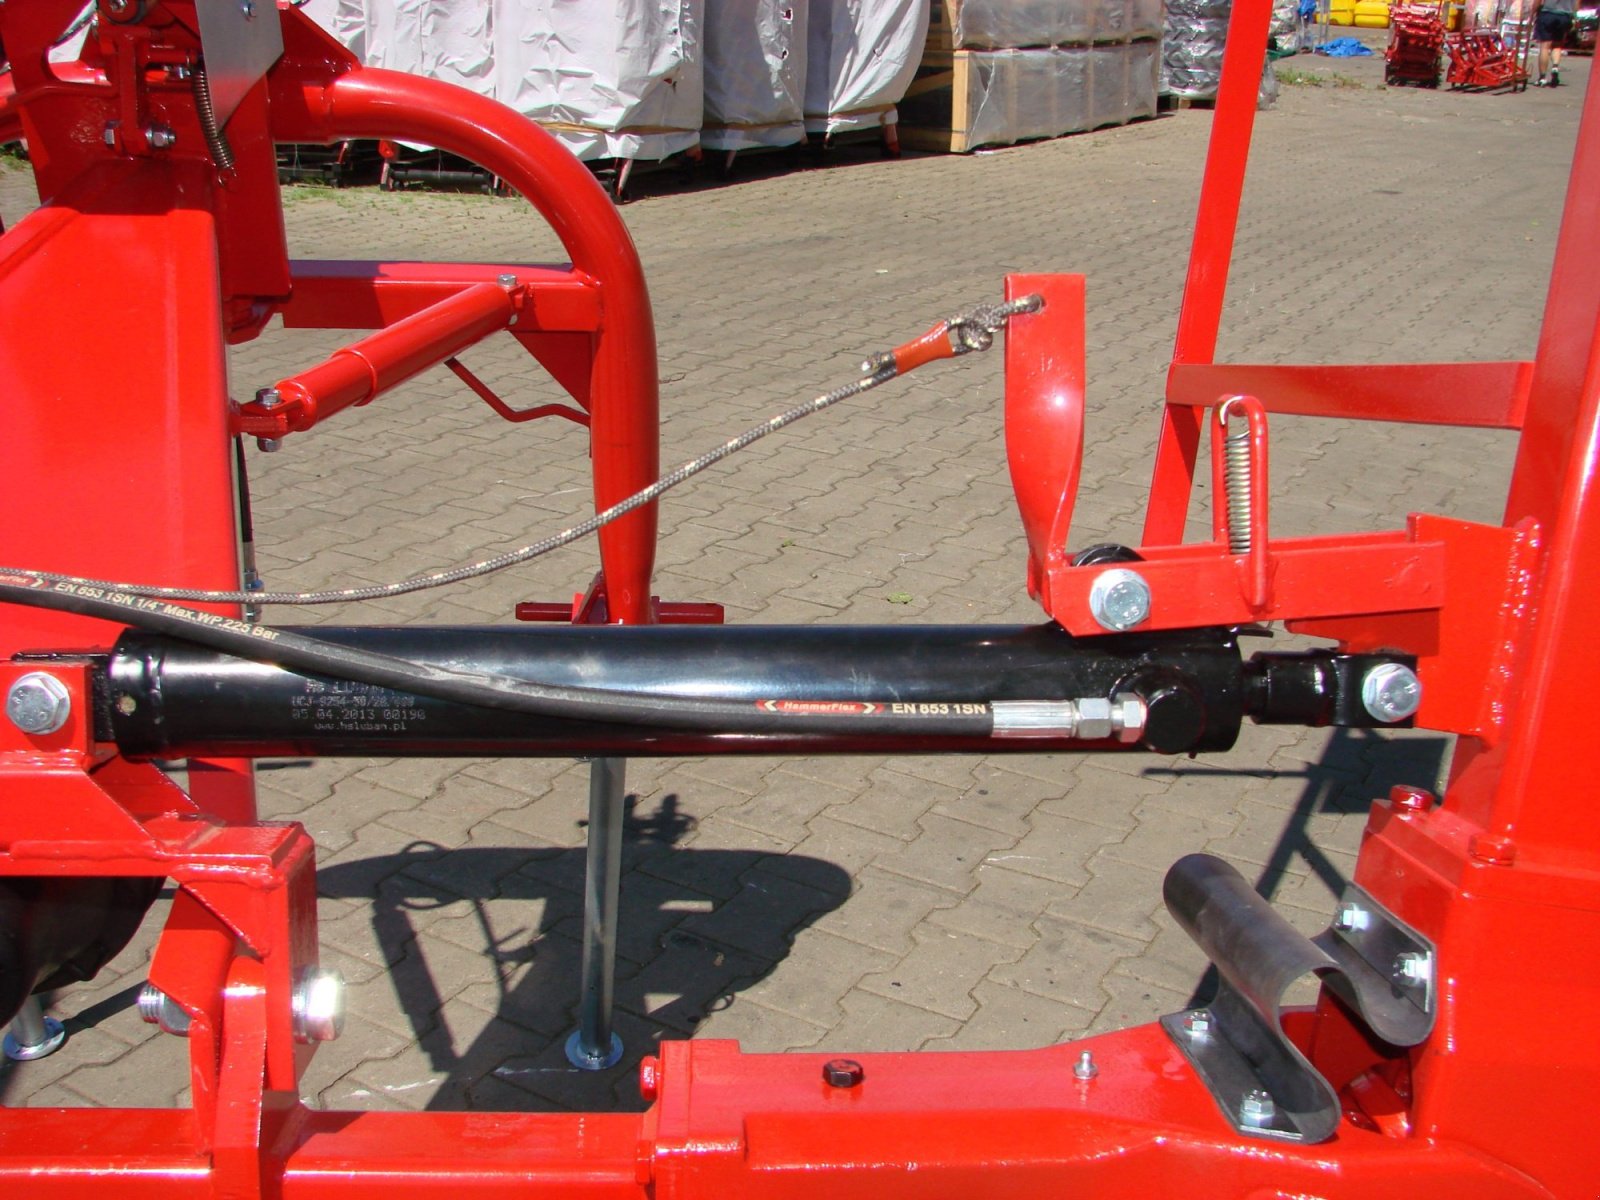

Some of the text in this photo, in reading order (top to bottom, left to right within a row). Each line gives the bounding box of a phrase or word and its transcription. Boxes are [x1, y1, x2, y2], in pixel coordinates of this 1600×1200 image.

[54, 582, 77, 593] EN
[78, 586, 105, 598] 853
[106, 592, 135, 605] 1SN
[251, 625, 281, 641] Bar
[783, 701, 987, 714] HammerFlex EN 853 1SN
